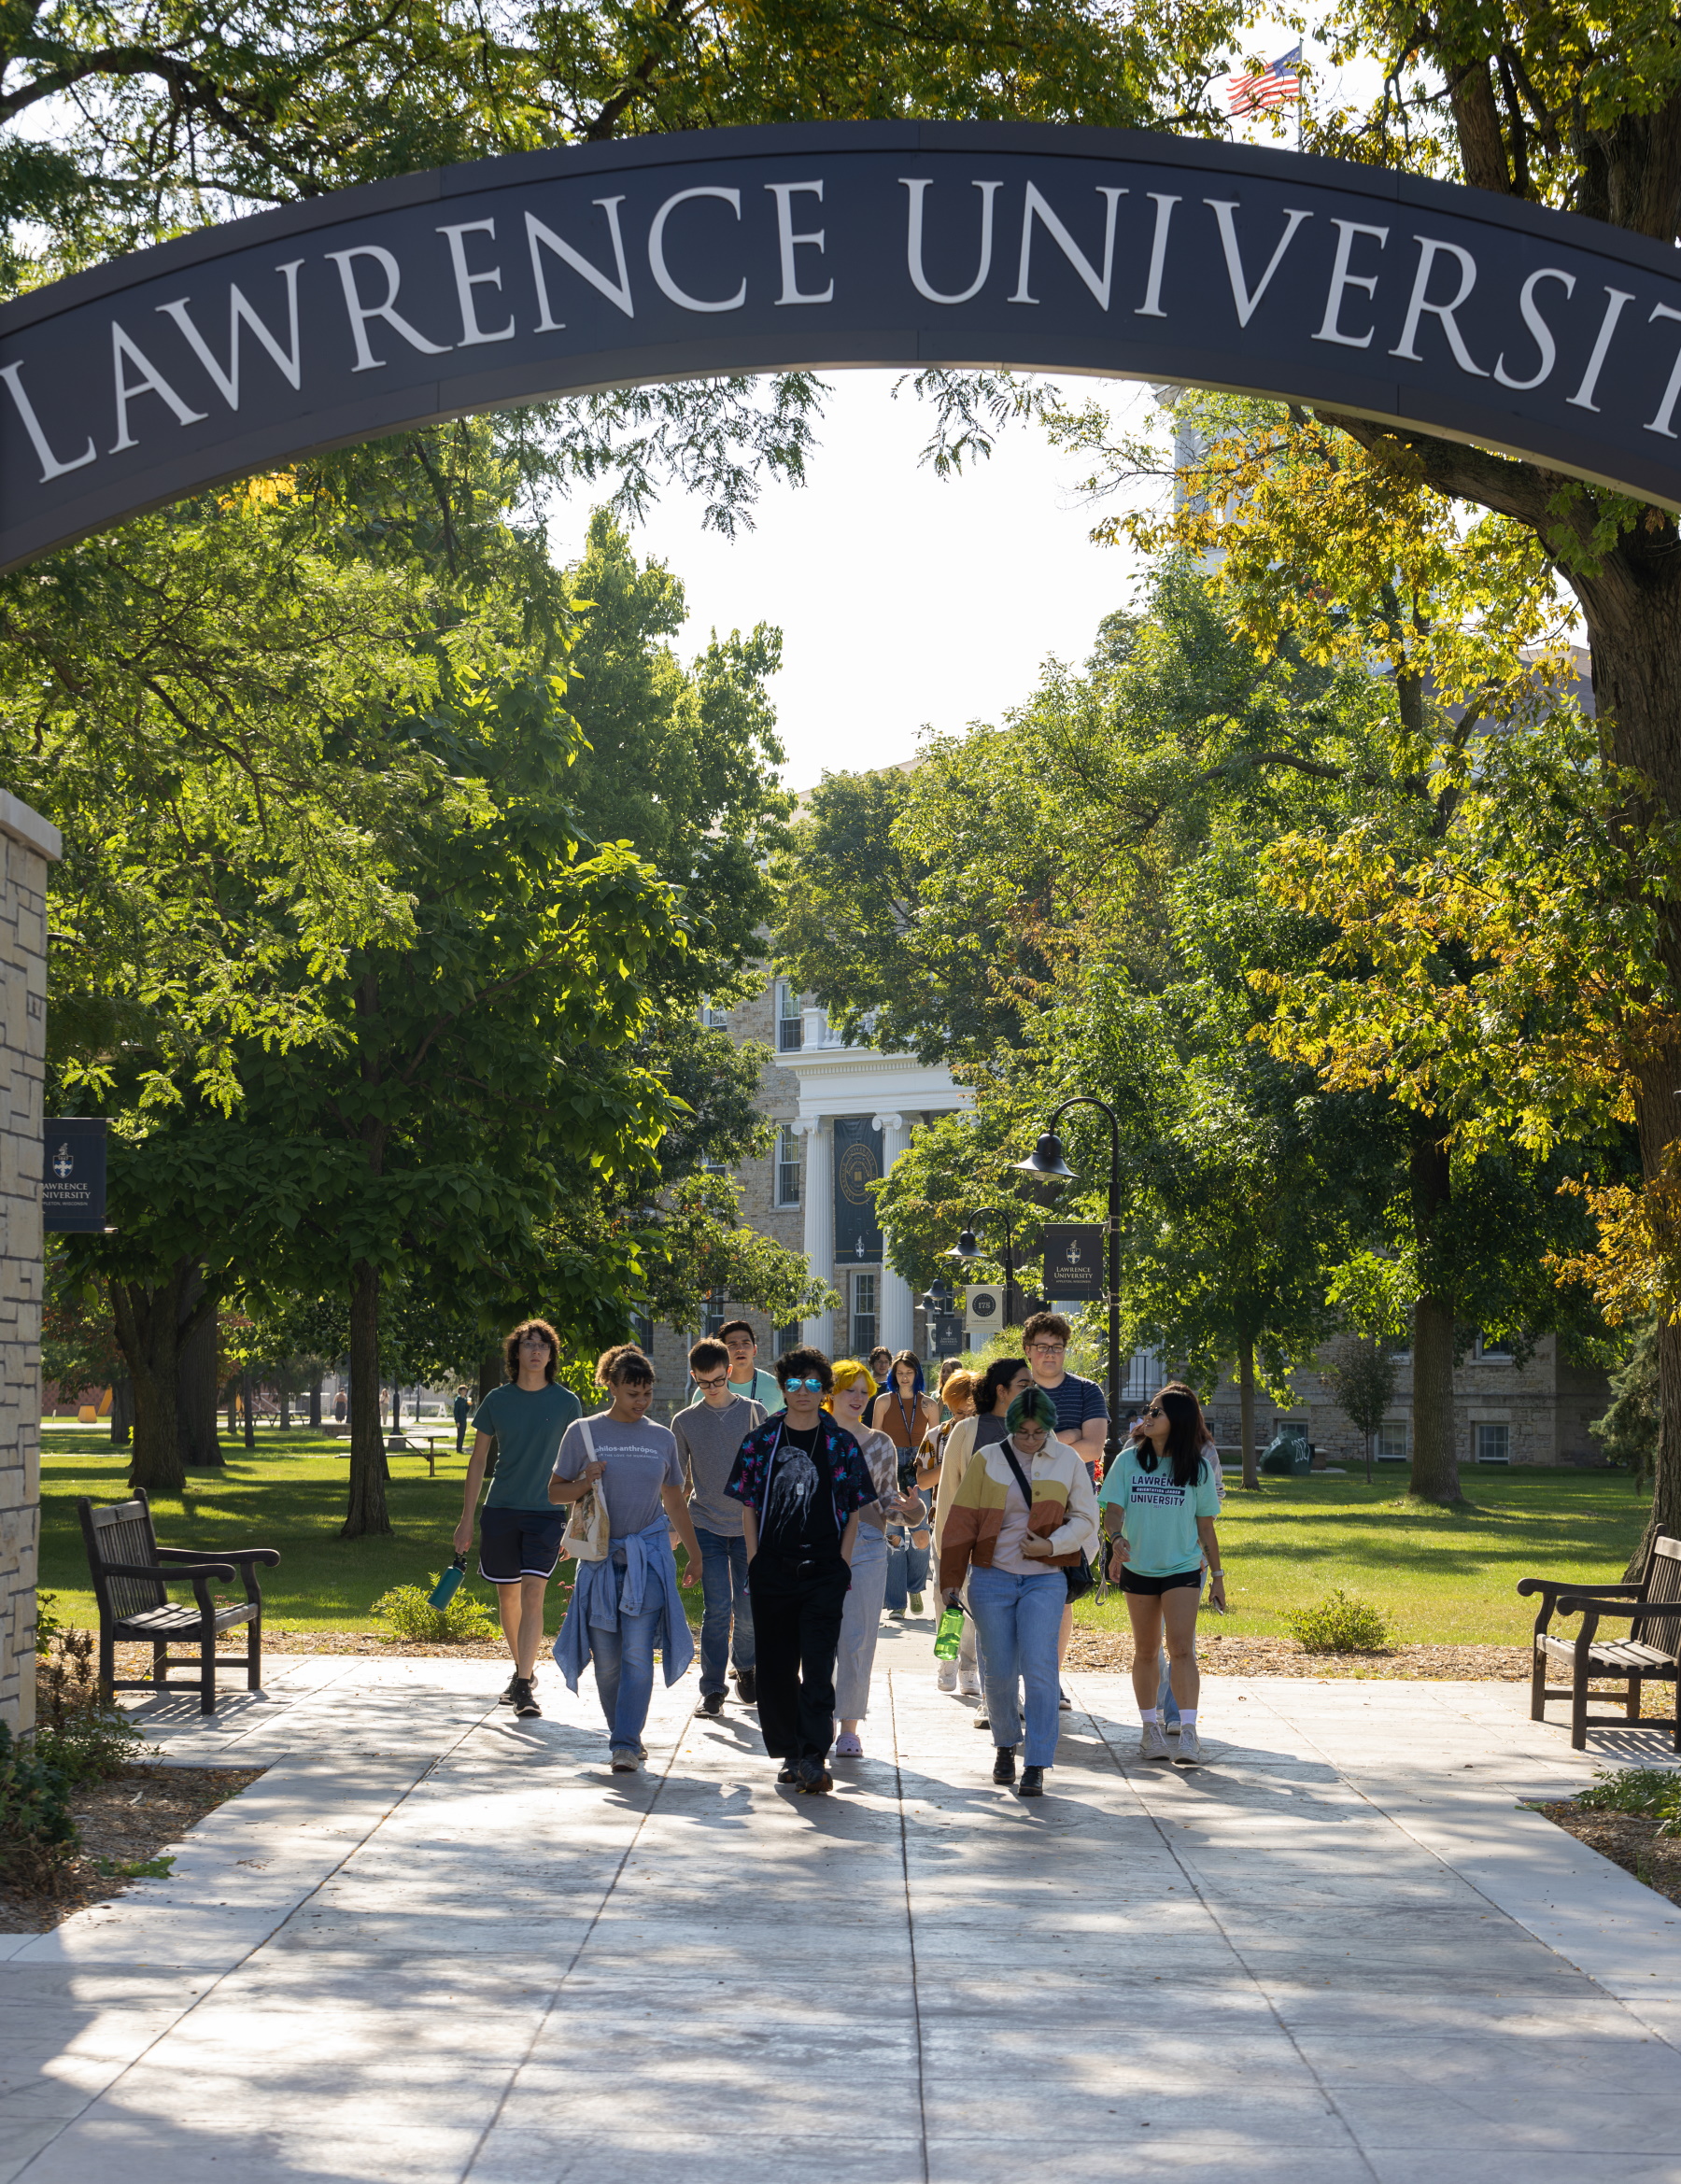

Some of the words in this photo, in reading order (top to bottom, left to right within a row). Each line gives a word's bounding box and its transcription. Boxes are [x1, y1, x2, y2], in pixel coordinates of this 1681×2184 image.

[0, 179, 834, 484] LAWRENCE
[897, 177, 1681, 440] UNIVERSIT
[1132, 1475, 1186, 1488] LAWREN
[1130, 1494, 1185, 1507] UNIVERSITY
